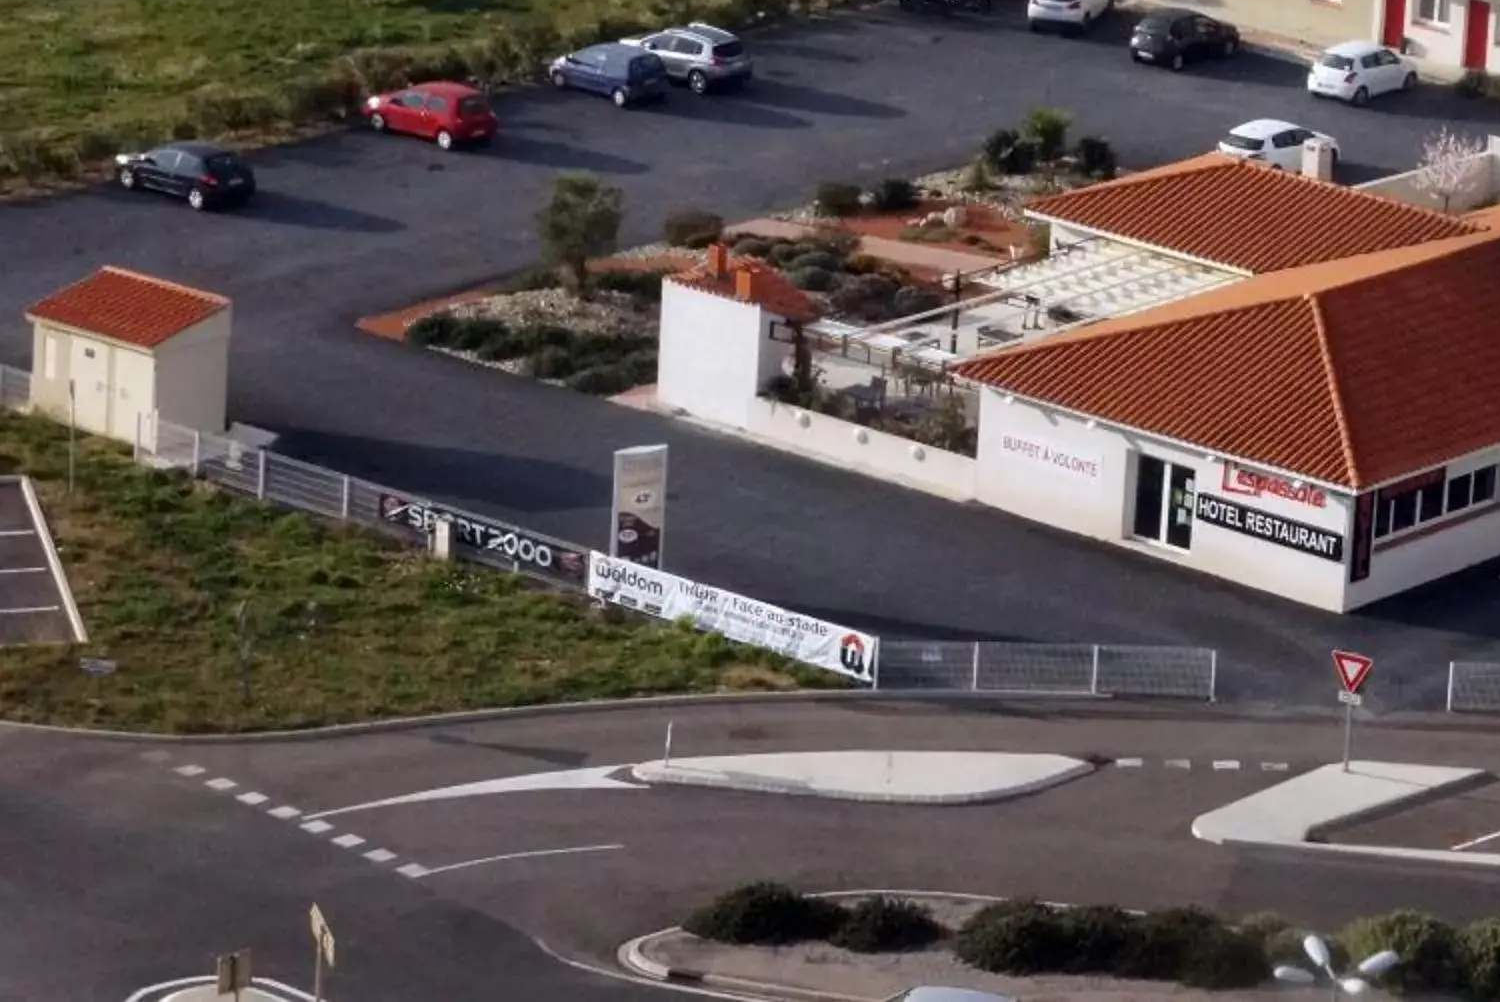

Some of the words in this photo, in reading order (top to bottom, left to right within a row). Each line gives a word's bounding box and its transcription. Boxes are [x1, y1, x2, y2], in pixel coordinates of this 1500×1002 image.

[1003, 435, 1040, 459] BUFFET
[1198, 497, 1243, 528] HOTEL
[1245, 511, 1337, 555] RESTAURANT
[767, 610, 785, 626] au
[786, 615, 830, 638] stade
